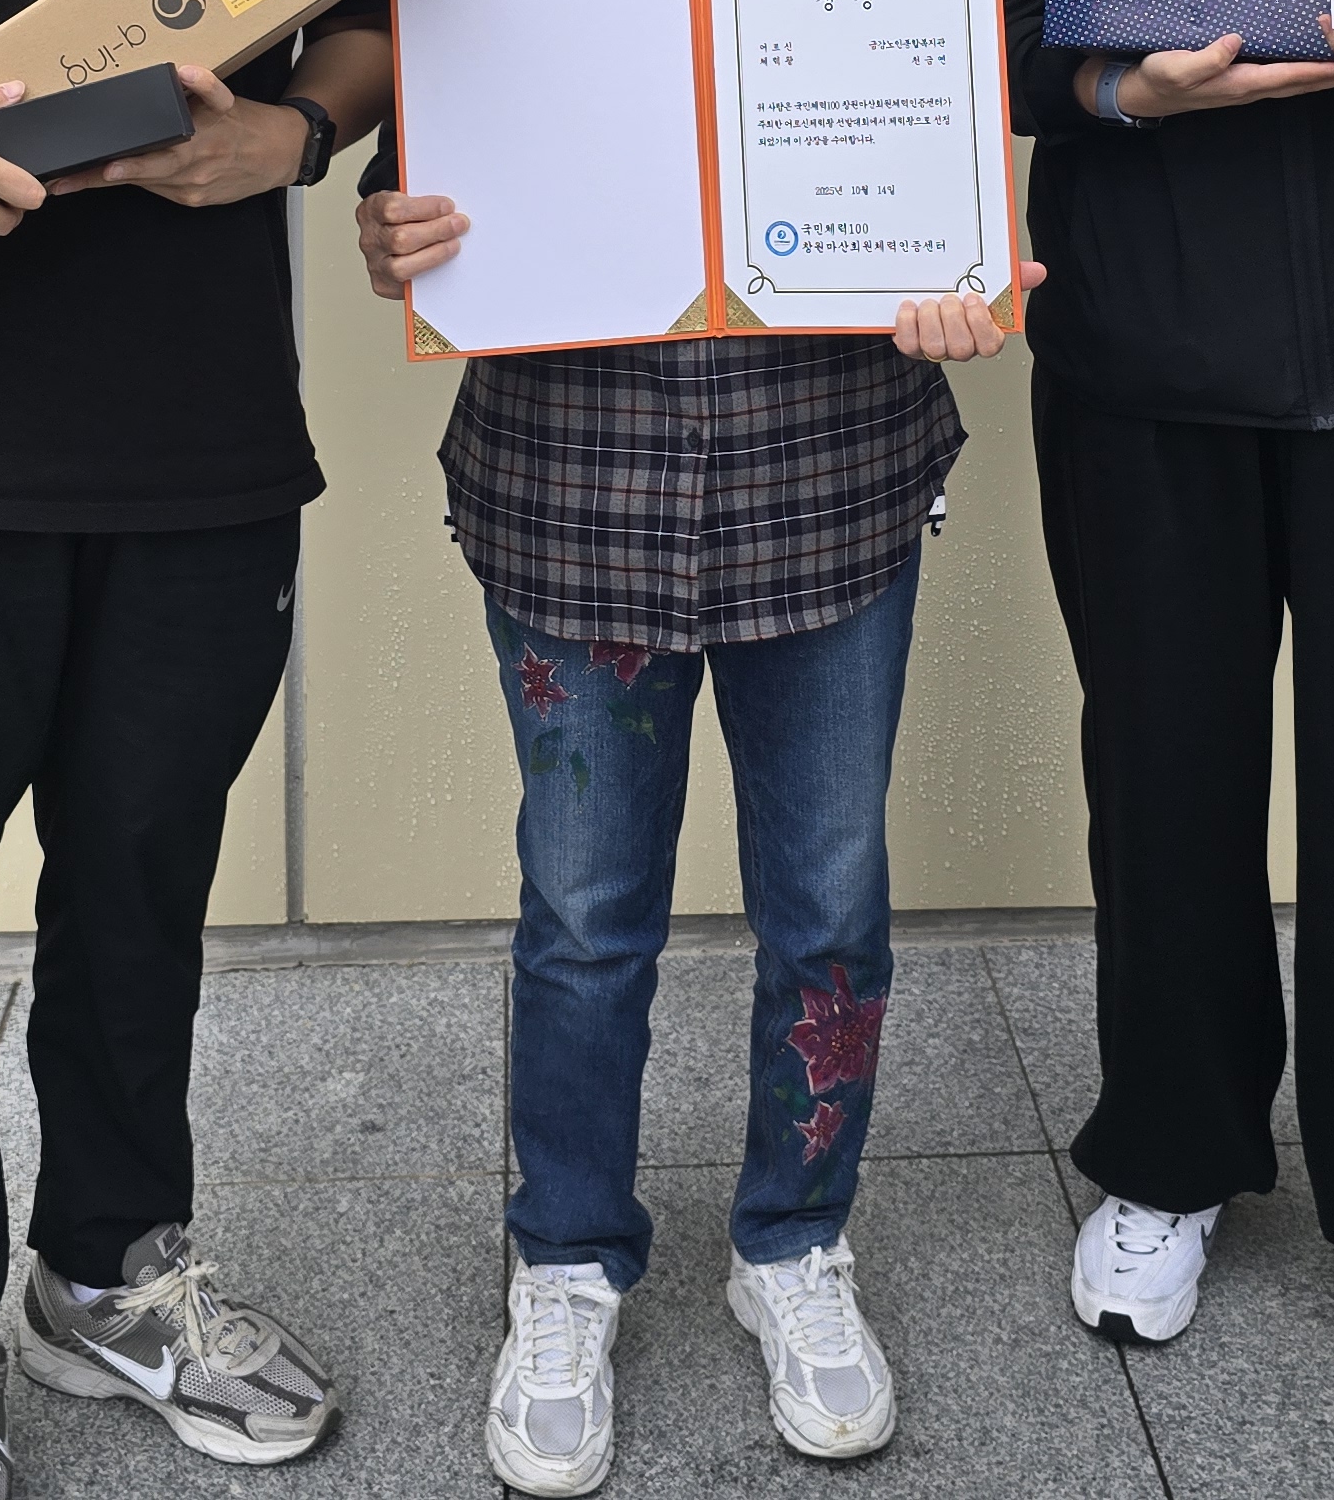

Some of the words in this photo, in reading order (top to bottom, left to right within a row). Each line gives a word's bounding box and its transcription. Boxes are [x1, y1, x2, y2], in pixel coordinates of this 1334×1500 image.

[794, 100, 840, 111] 국민체력100
[815, 184, 843, 196] 2025년
[851, 184, 869, 196] 10월
[877, 184, 895, 196] 14일
[800, 222, 869, 236] 국민체력100
[801, 239, 946, 254] 창원마산회원체력인증센터
